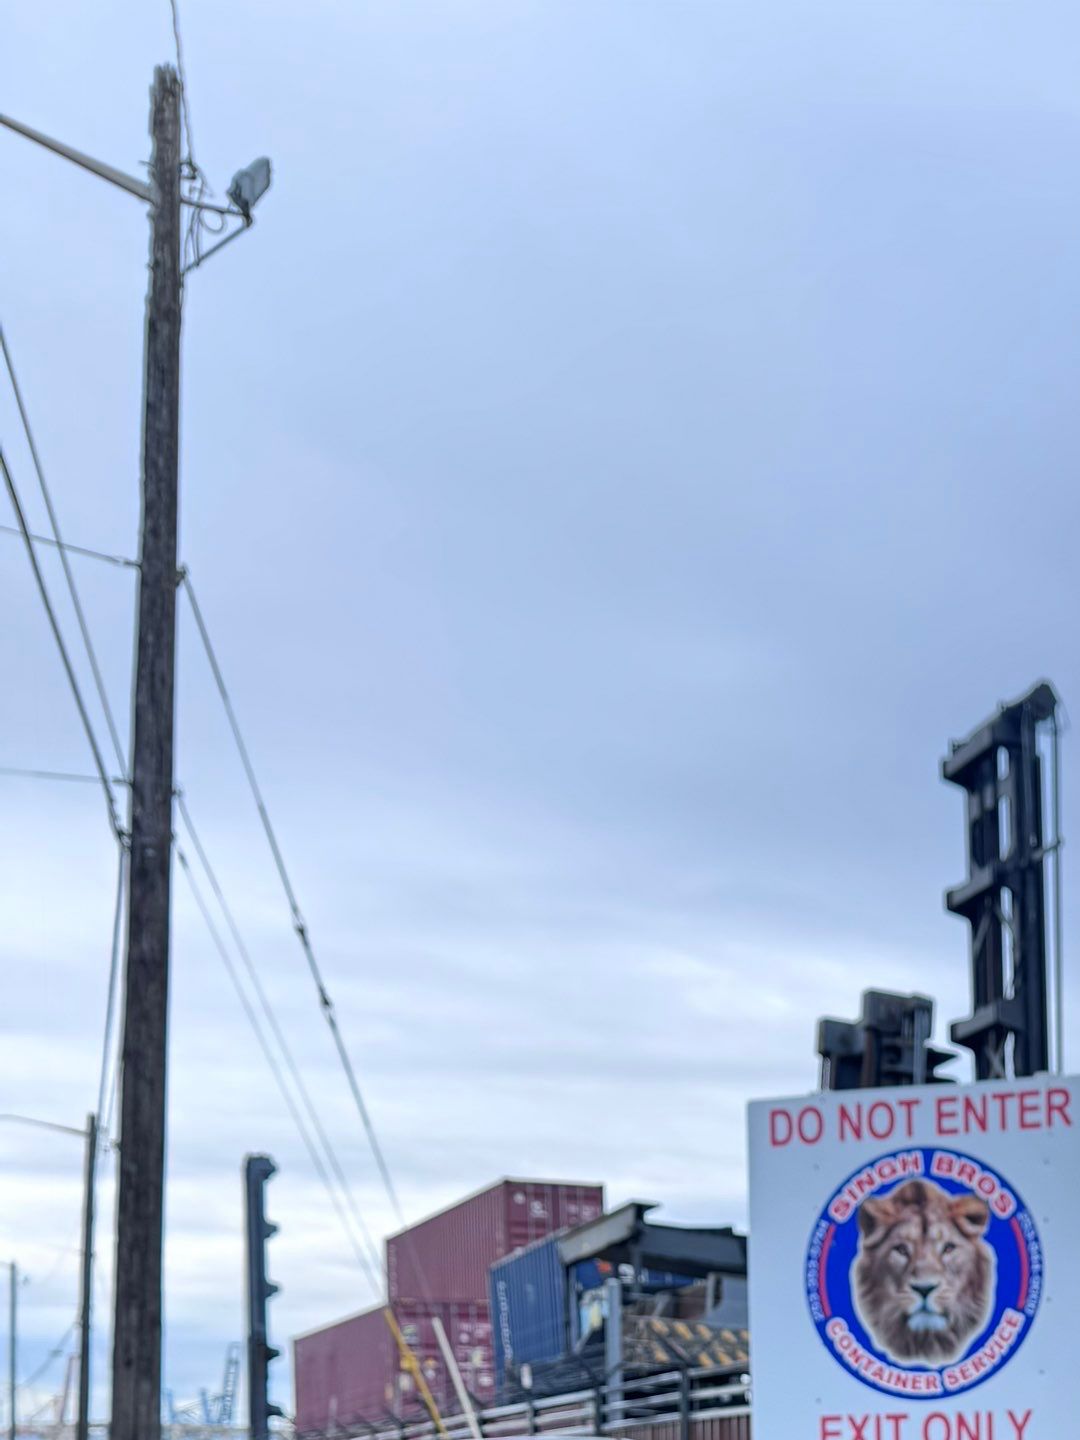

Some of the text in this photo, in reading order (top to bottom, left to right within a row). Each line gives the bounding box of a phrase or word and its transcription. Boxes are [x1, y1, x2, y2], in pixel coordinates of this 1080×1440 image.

[770, 1088, 1073, 1148] DO NOT ENTER
[830, 1151, 1017, 1221] SINGH BROS
[827, 1309, 1024, 1393] CONTAINER SERVICE
